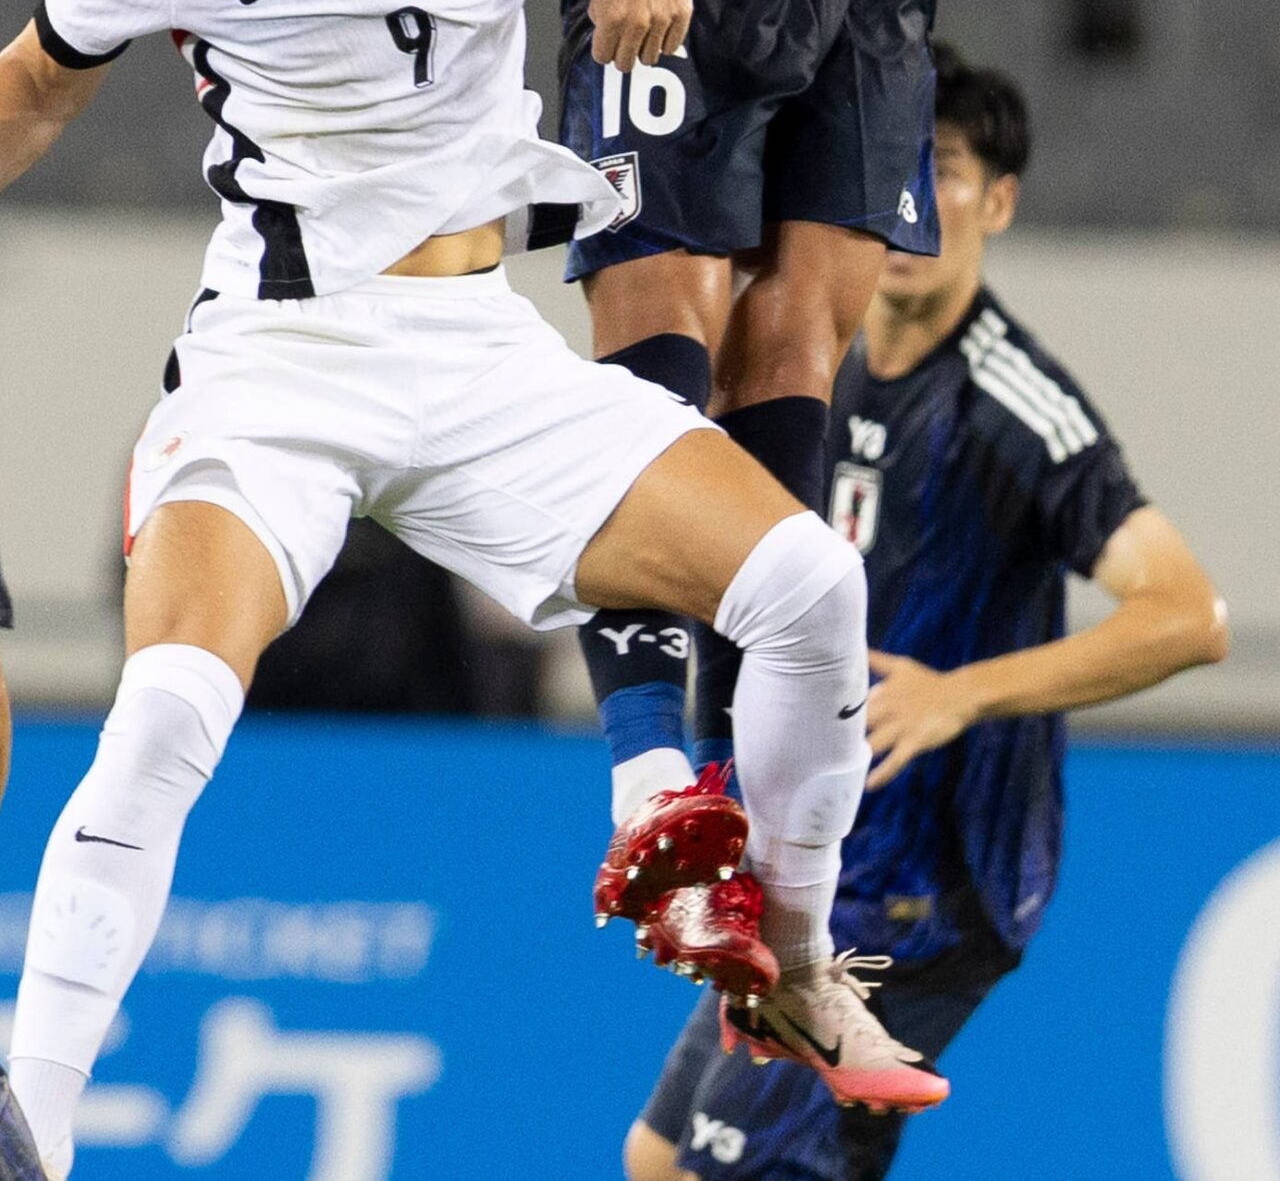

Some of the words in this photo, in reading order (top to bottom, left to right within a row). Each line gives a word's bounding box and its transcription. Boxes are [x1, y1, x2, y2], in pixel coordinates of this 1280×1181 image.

[385, 5, 438, 89] 9
[602, 45, 688, 139] 16
[596, 622, 692, 660] Y-3
